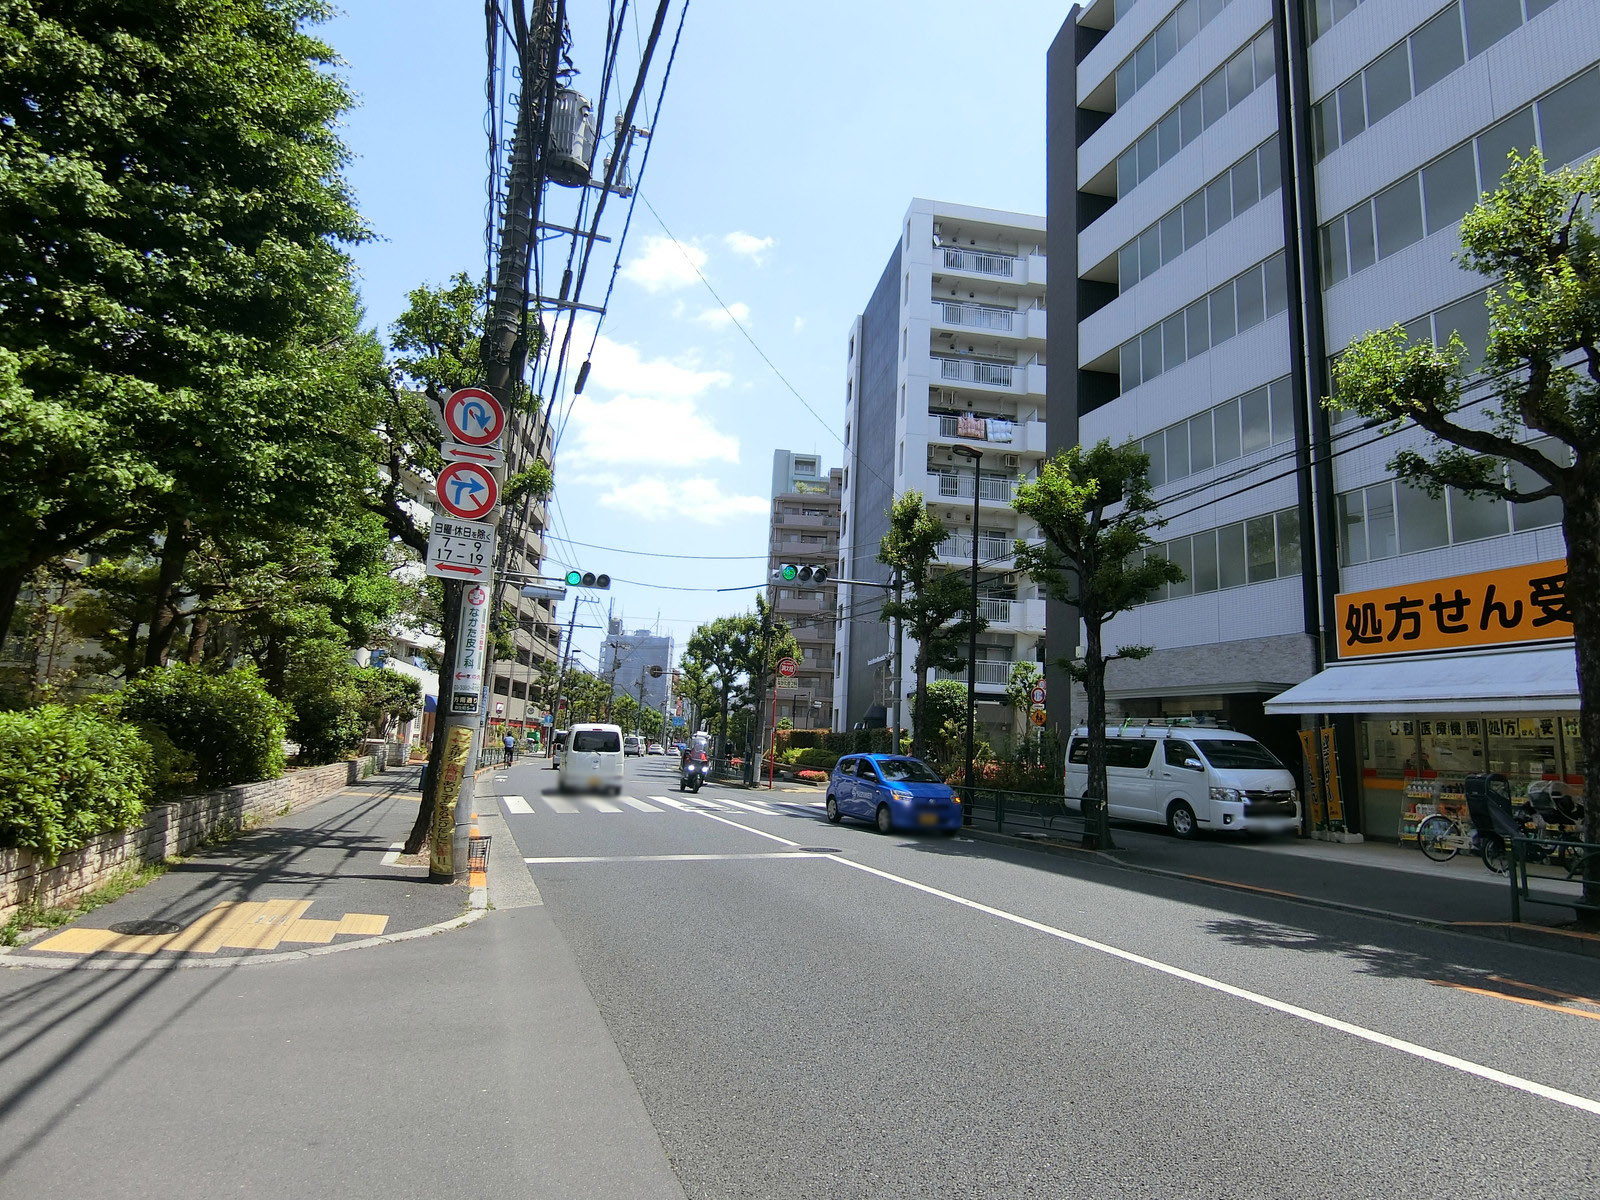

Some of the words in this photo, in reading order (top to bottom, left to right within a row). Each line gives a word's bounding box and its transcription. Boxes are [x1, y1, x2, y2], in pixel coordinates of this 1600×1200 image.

[463, 607, 480, 669] なかた皮フ科
[1345, 572, 1575, 646] 処方せん受
